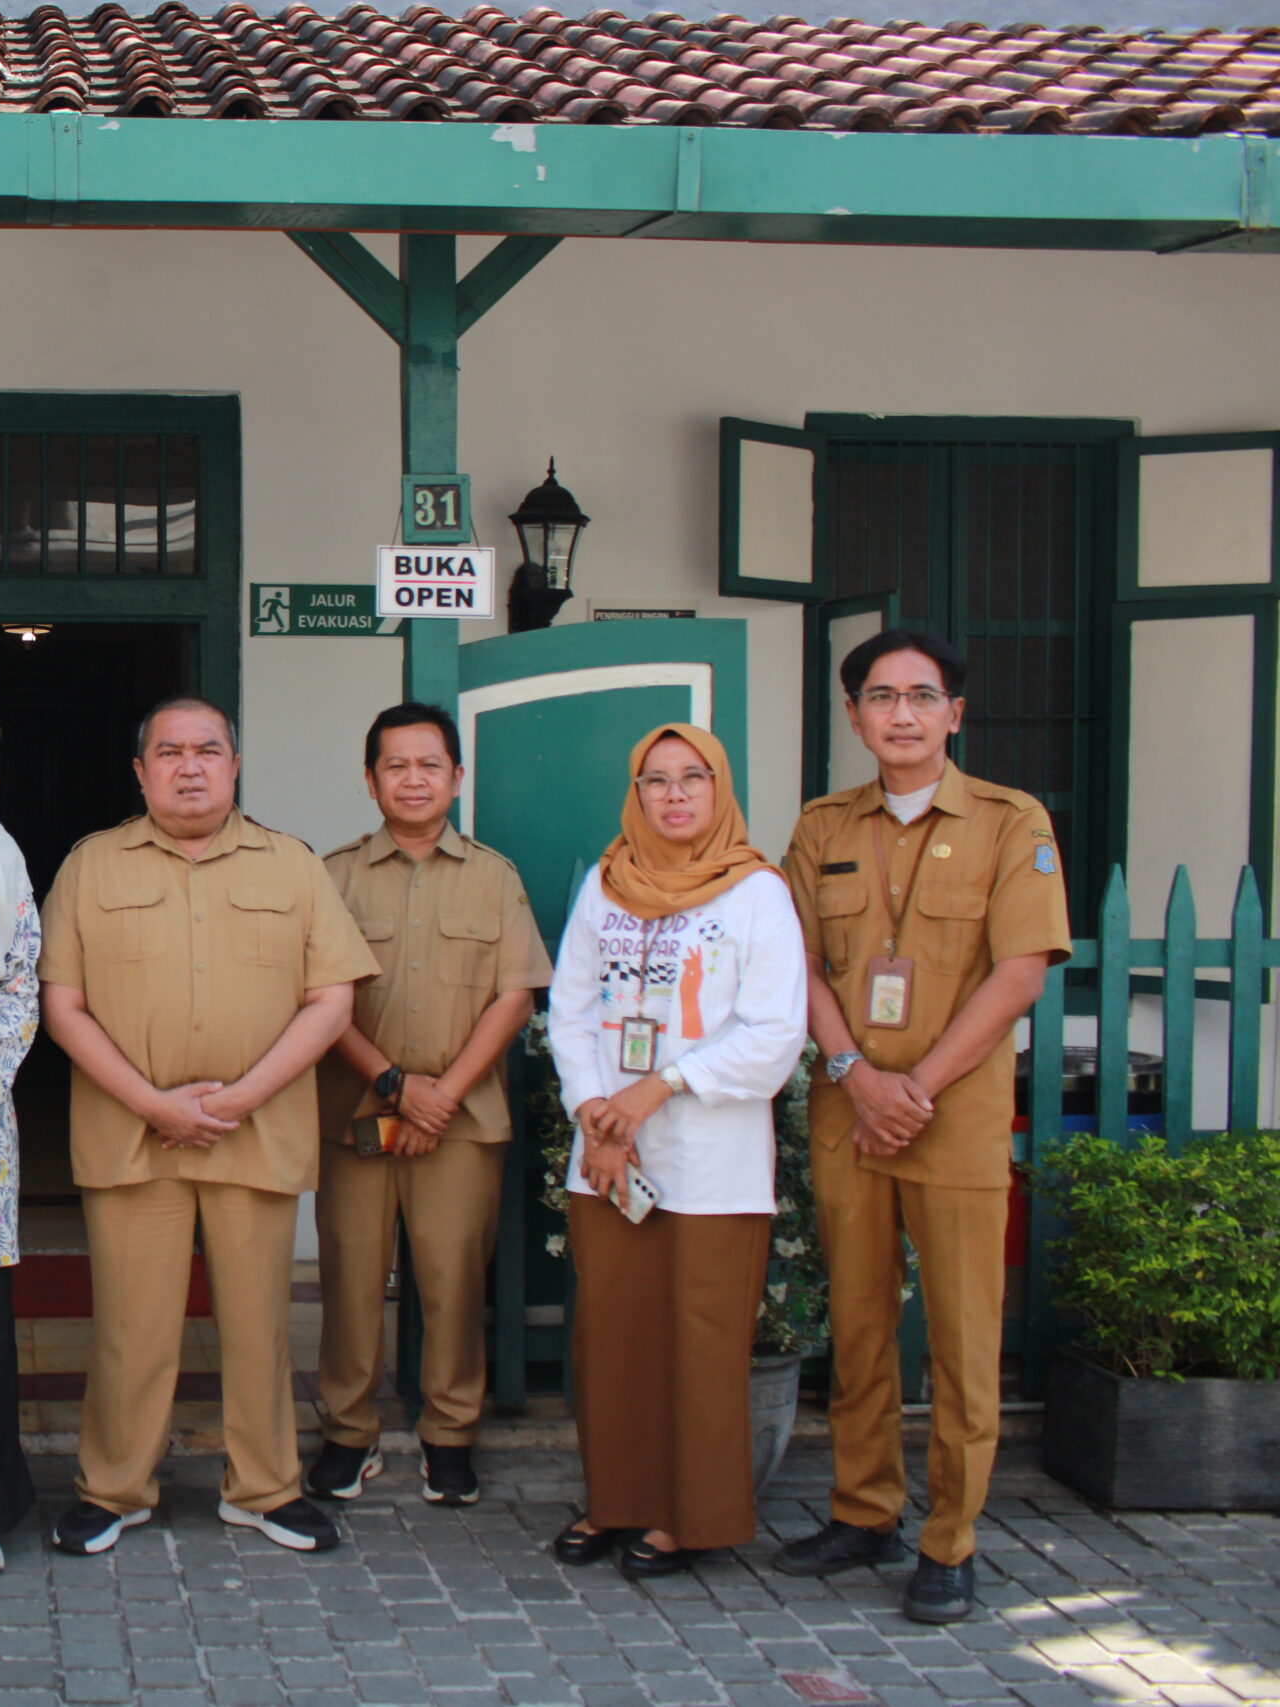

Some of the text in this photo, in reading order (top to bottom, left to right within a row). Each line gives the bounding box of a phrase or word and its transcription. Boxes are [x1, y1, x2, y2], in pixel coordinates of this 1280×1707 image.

[415, 489, 457, 526] 31
[394, 555, 477, 577] BUKA
[309, 594, 357, 607] JALUR
[394, 587, 474, 608] OPEN
[298, 615, 372, 628] EVAKUASI
